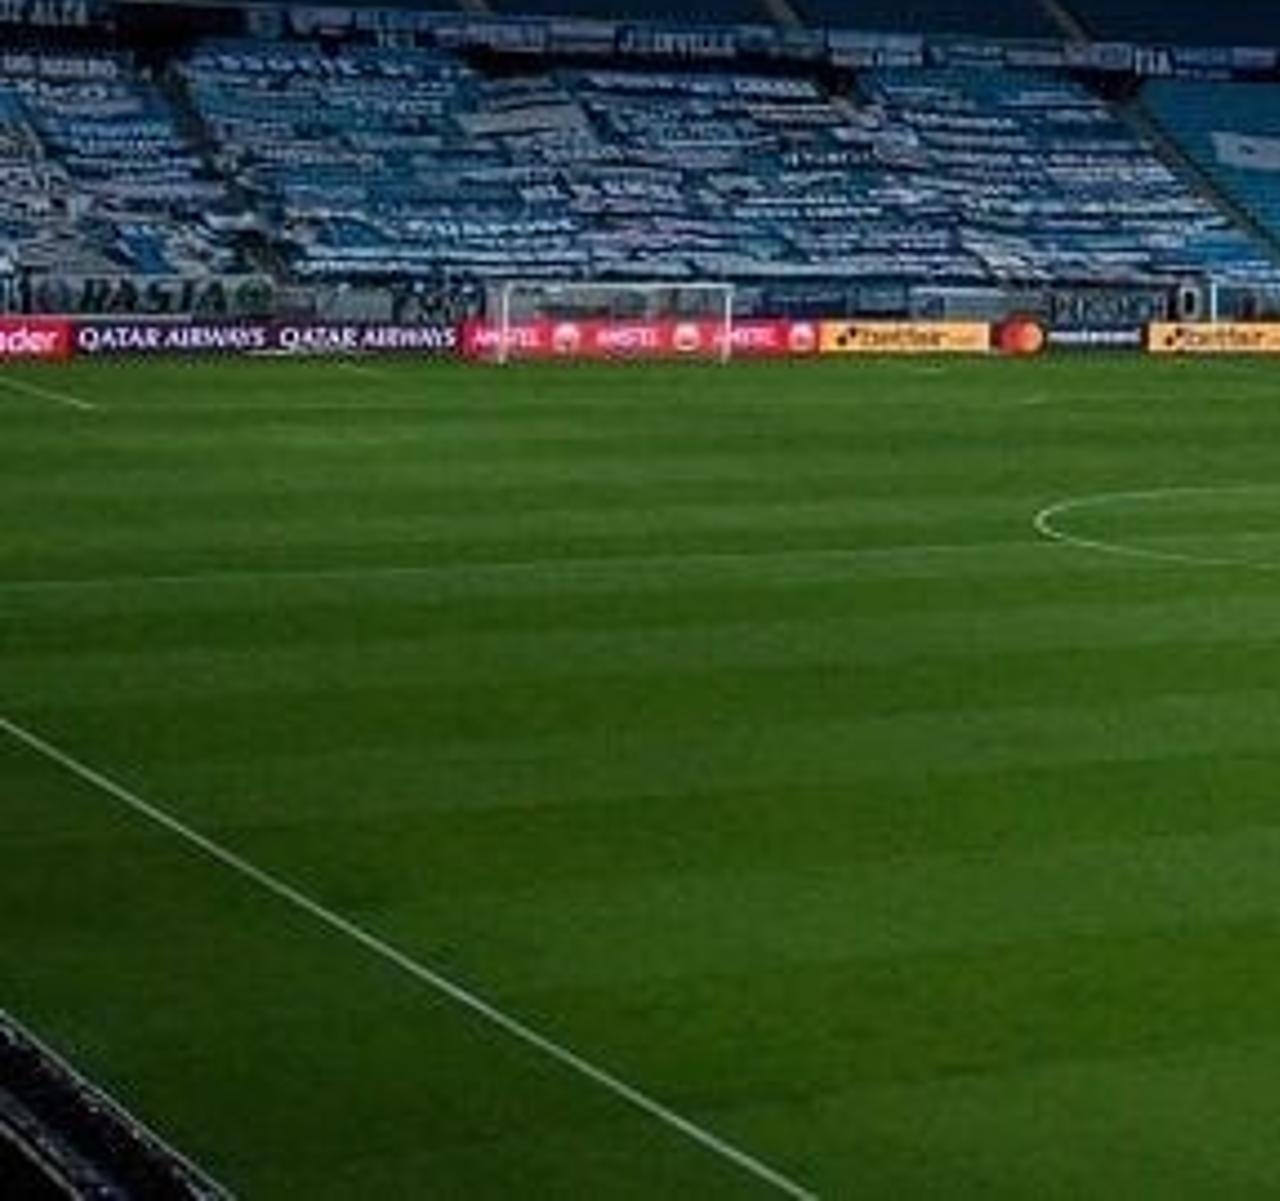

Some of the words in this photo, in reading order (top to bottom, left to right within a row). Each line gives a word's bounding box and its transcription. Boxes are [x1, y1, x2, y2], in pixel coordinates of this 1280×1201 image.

[78, 326, 159, 349] QATAR
[164, 326, 267, 347] AIRWAYS
[278, 326, 357, 349] QATAR
[364, 326, 456, 347] AIRWAYS
